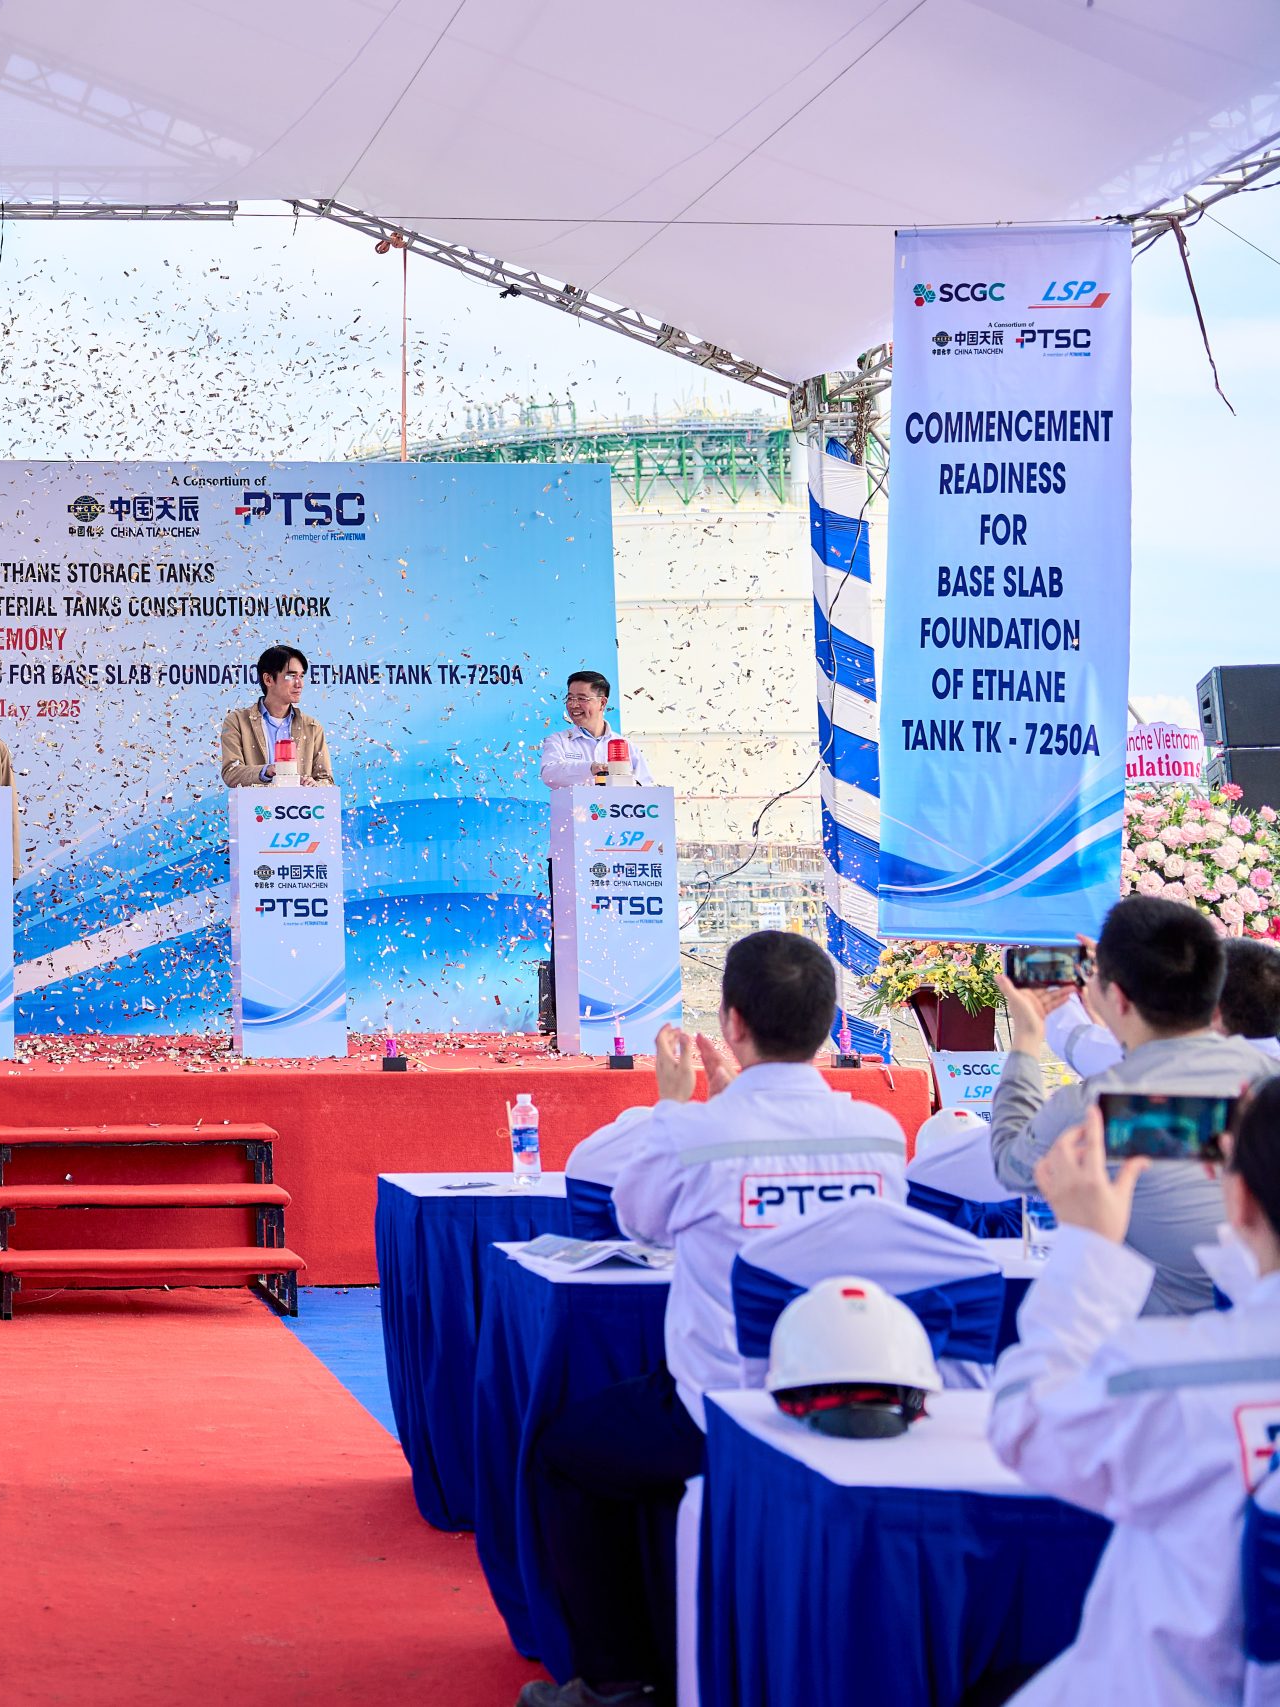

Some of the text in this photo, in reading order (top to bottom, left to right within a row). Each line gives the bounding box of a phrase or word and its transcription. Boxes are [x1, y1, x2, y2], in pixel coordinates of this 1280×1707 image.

[939, 283, 1005, 302] SCGC
[1042, 281, 1097, 301] LSP
[954, 331, 1004, 346] 中国天辰
[1016, 329, 1091, 349] PTSC
[905, 410, 1114, 444] COMMENCEMENT
[171, 475, 267, 486] A Consortium of
[939, 461, 1066, 495] READINESS
[109, 496, 199, 522] 中国天辰
[235, 492, 365, 526] PTSC
[111, 527, 144, 537] CHINA
[980, 513, 1027, 546] FOR
[67, 563, 150, 583] STORAGE
[157, 563, 215, 583] TANKS
[937, 566, 1064, 598] BASE SLAB
[63, 597, 122, 617] TANKS
[129, 597, 269, 617] CONSTRUCTION
[276, 597, 331, 617] WORK
[920, 617, 1080, 651] FOUNDATION
[10, 664, 45, 684] FOR
[52, 664, 99, 684] BASE
[105, 664, 151, 684] SLAB
[158, 664, 260, 685] FOUNDATIO
[310, 665, 380, 685] ETHANE
[385, 665, 433, 684] TANK
[437, 665, 523, 685] TK-7250A
[932, 668, 1066, 703] OF ETHANE
[36, 699, 81, 718] 2025
[902, 719, 964, 751] TANK
[972, 721, 1002, 753] TK
[1025, 722, 1100, 757] 7250A
[1127, 728, 1200, 751] nche Vietnam
[274, 805, 325, 820] SCGC
[609, 804, 659, 818] SCGC
[269, 832, 310, 848] LSP
[605, 831, 644, 846] LSP
[277, 865, 328, 879] 中国天辰
[612, 863, 662, 878] 中国天辰
[255, 898, 328, 917] PTSC
[591, 896, 663, 915] PTSC
[962, 1064, 1001, 1075] SCGC
[964, 1085, 993, 1098] LSP
